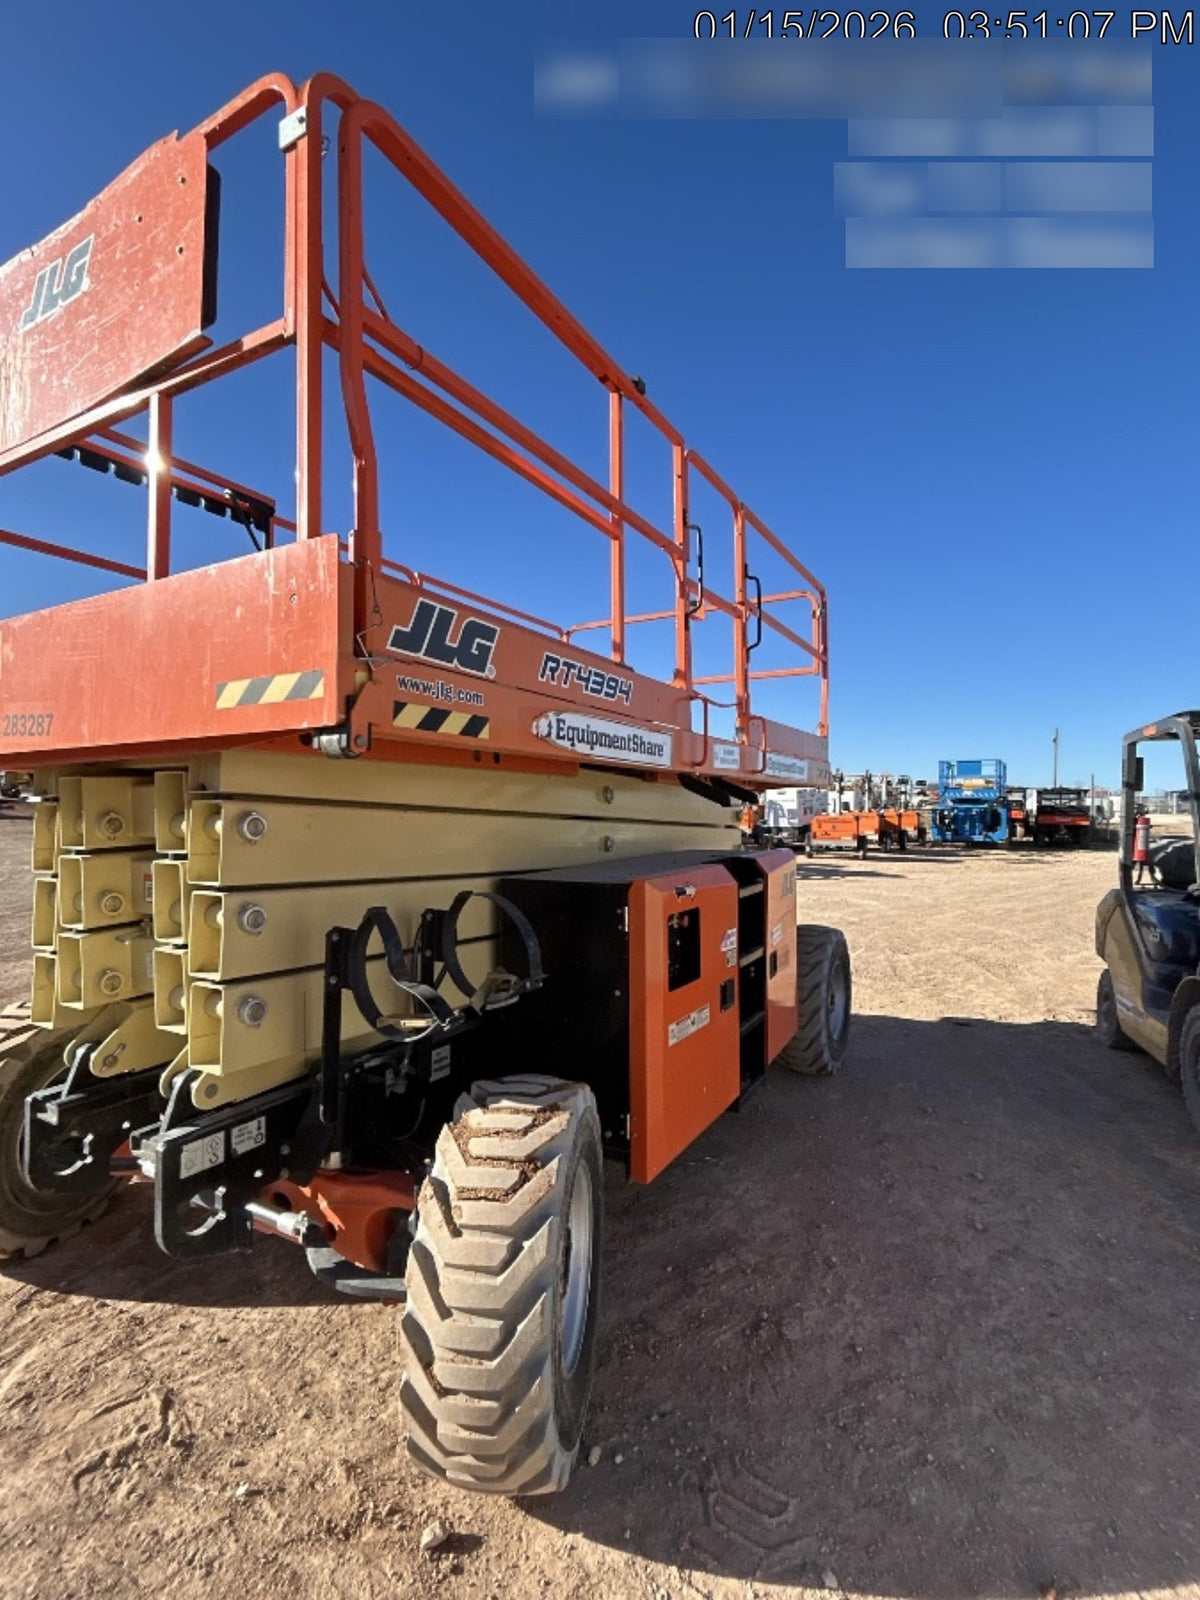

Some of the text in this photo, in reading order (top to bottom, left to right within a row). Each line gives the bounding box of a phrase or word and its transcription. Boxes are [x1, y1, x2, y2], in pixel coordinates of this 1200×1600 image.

[19, 233, 95, 333] JLG
[386, 597, 500, 678] JLG
[396, 675, 484, 706] www.jlg.com
[538, 651, 633, 706] RT4394
[2, 712, 55, 737] 283287
[555, 717, 665, 758] EquipmentShare
